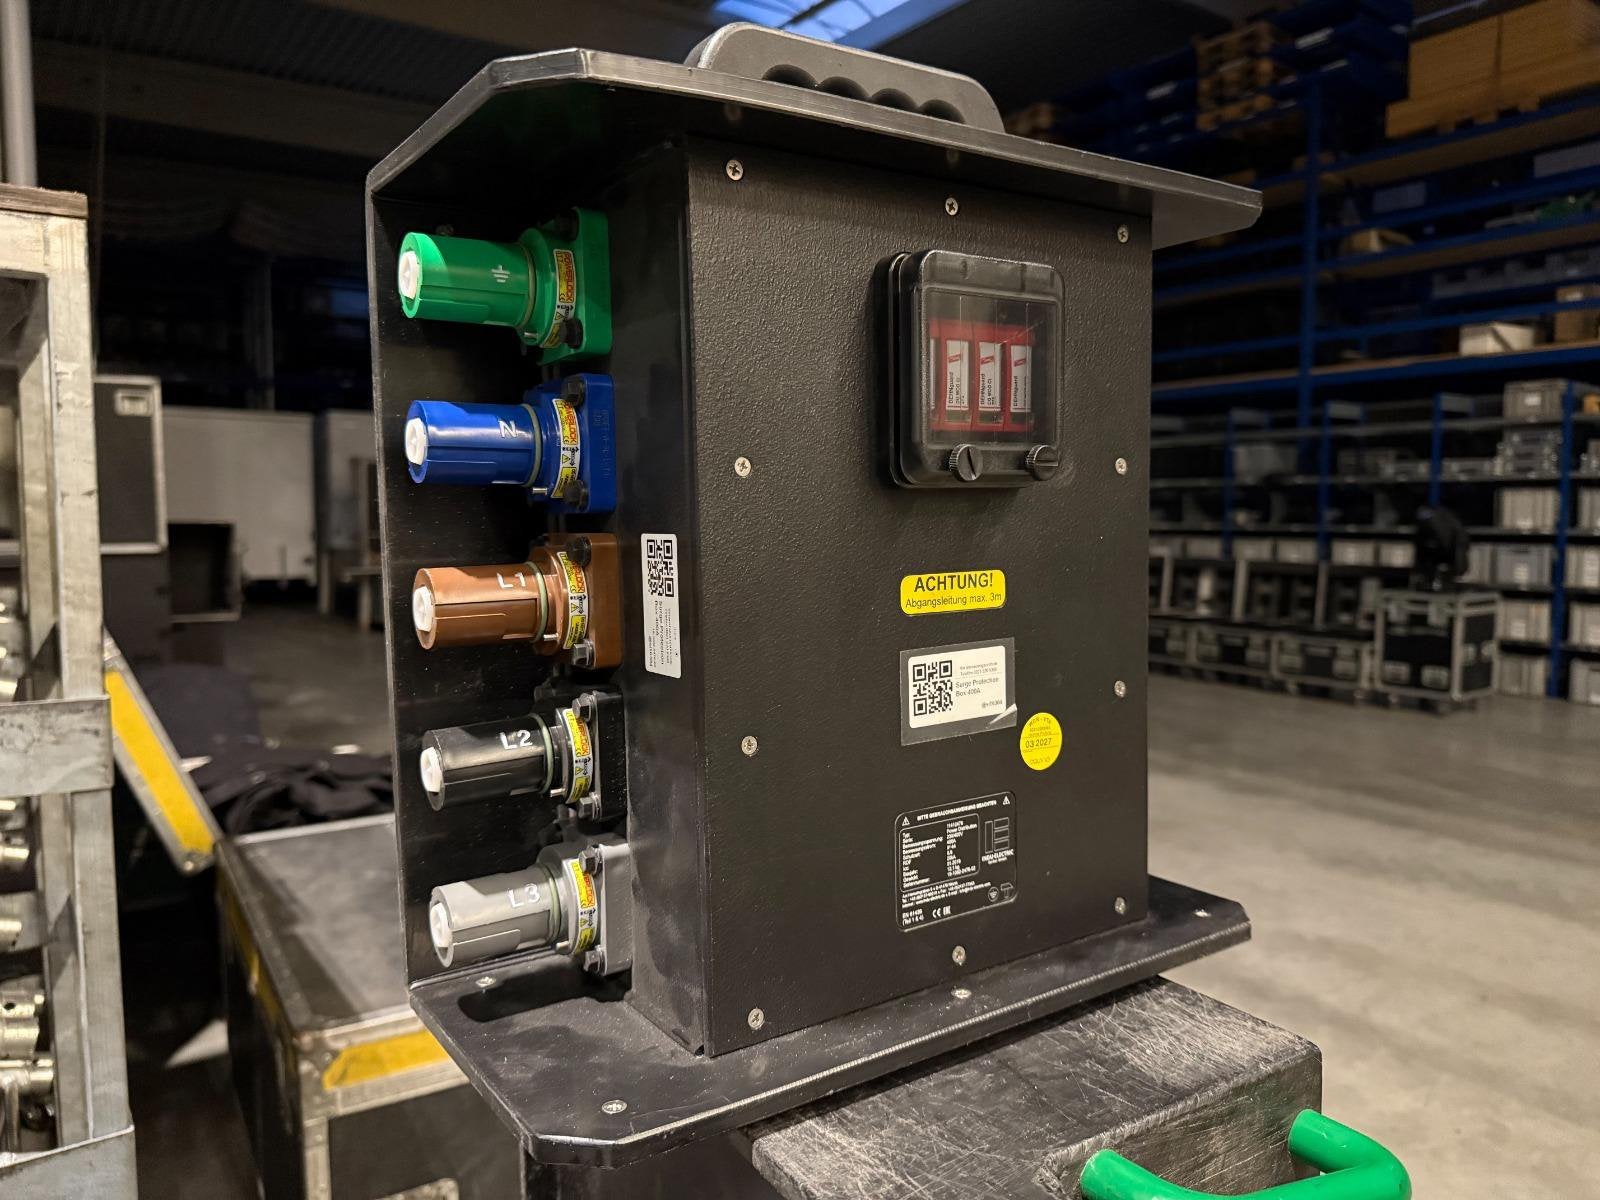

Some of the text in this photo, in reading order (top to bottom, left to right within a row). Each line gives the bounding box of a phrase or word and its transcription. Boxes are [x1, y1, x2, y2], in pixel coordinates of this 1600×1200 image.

[563, 251, 574, 303] POWERLOCK
[499, 420, 518, 438] N
[497, 572, 527, 589] L1
[914, 572, 993, 592] ACHTUNG!
[905, 592, 1002, 609] Abgangsleitung max. 3m
[955, 680, 971, 690] Surge
[955, 687, 981, 697] Box 400A
[500, 730, 533, 750] L2
[1025, 737, 1052, 748] 03 2027
[508, 883, 541, 908] L3
